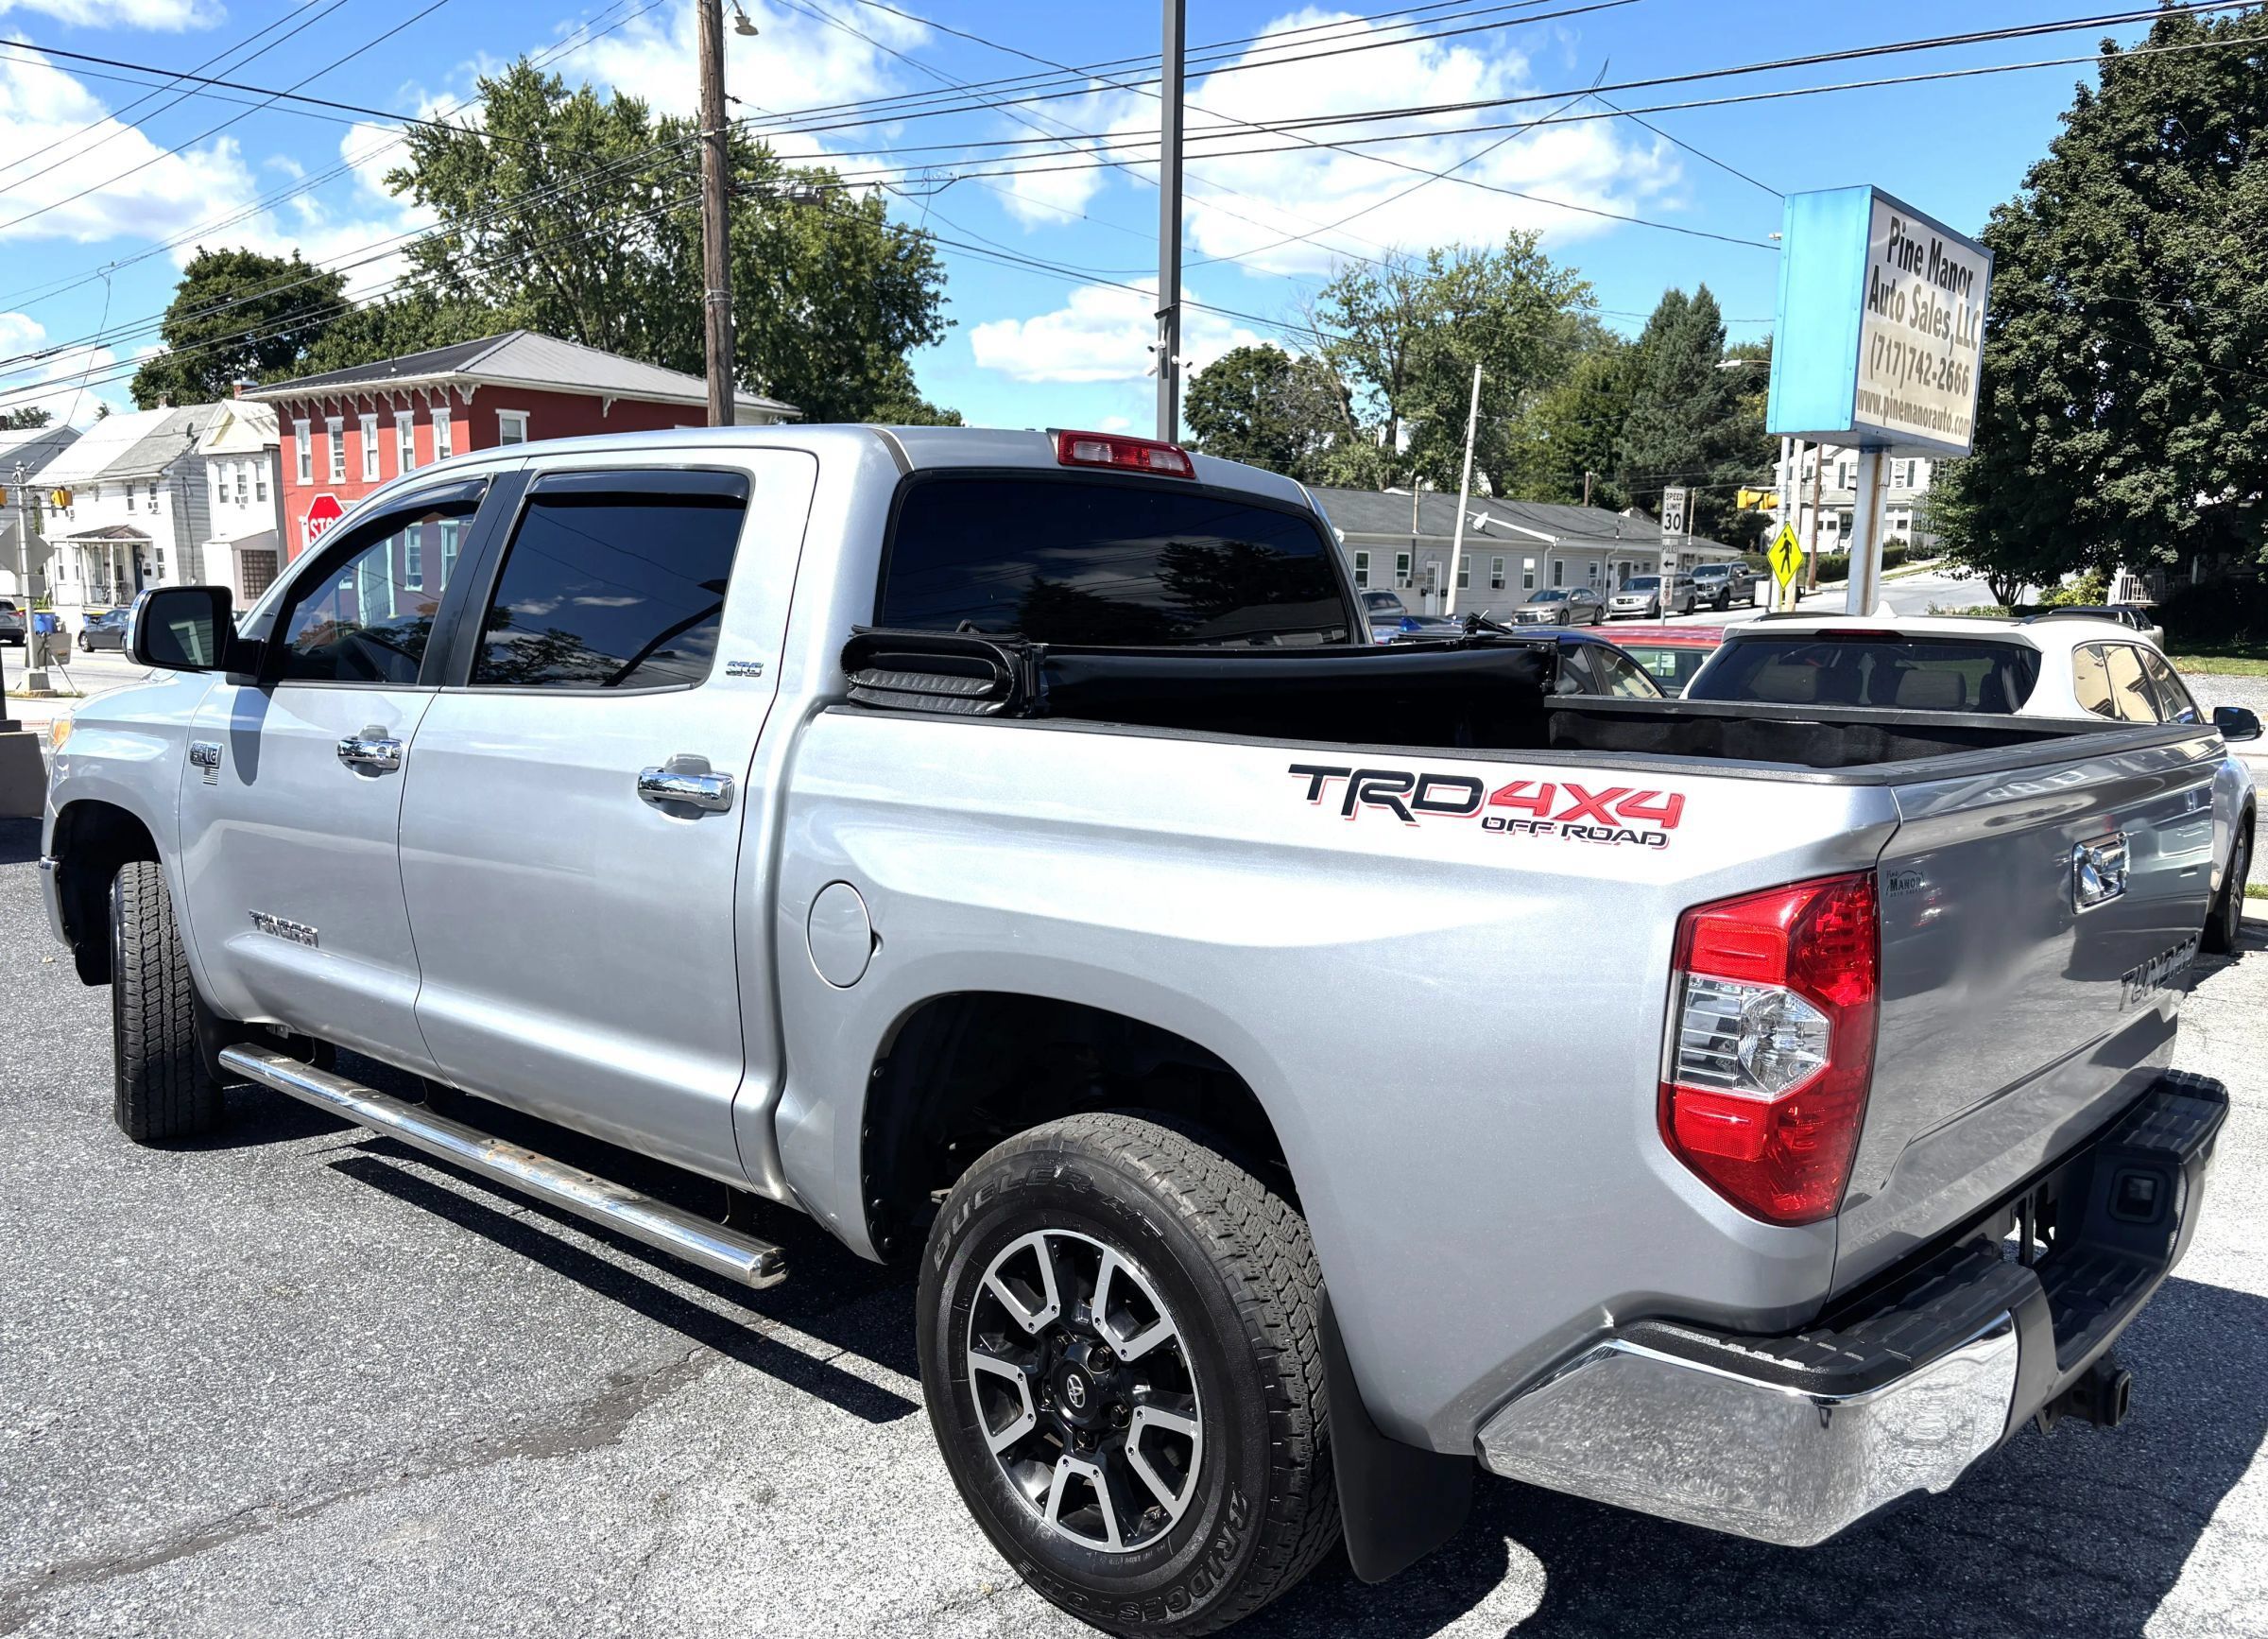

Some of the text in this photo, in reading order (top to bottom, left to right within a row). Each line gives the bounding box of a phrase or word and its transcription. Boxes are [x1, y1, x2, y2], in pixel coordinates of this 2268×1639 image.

[1886, 216, 1974, 299] Pine Manor
[1867, 265, 1906, 323] Auto
[1857, 388, 1971, 438] www.pinemanorauto.com
[1664, 512, 1681, 530] 30
[1665, 492, 1683, 501] SPEED
[1662, 544, 1677, 554] POLICE
[1288, 763, 1686, 830] TRD 4X4
[1481, 816, 1671, 850] OFF ROAD
[933, 1165, 1095, 1272] DUELER
